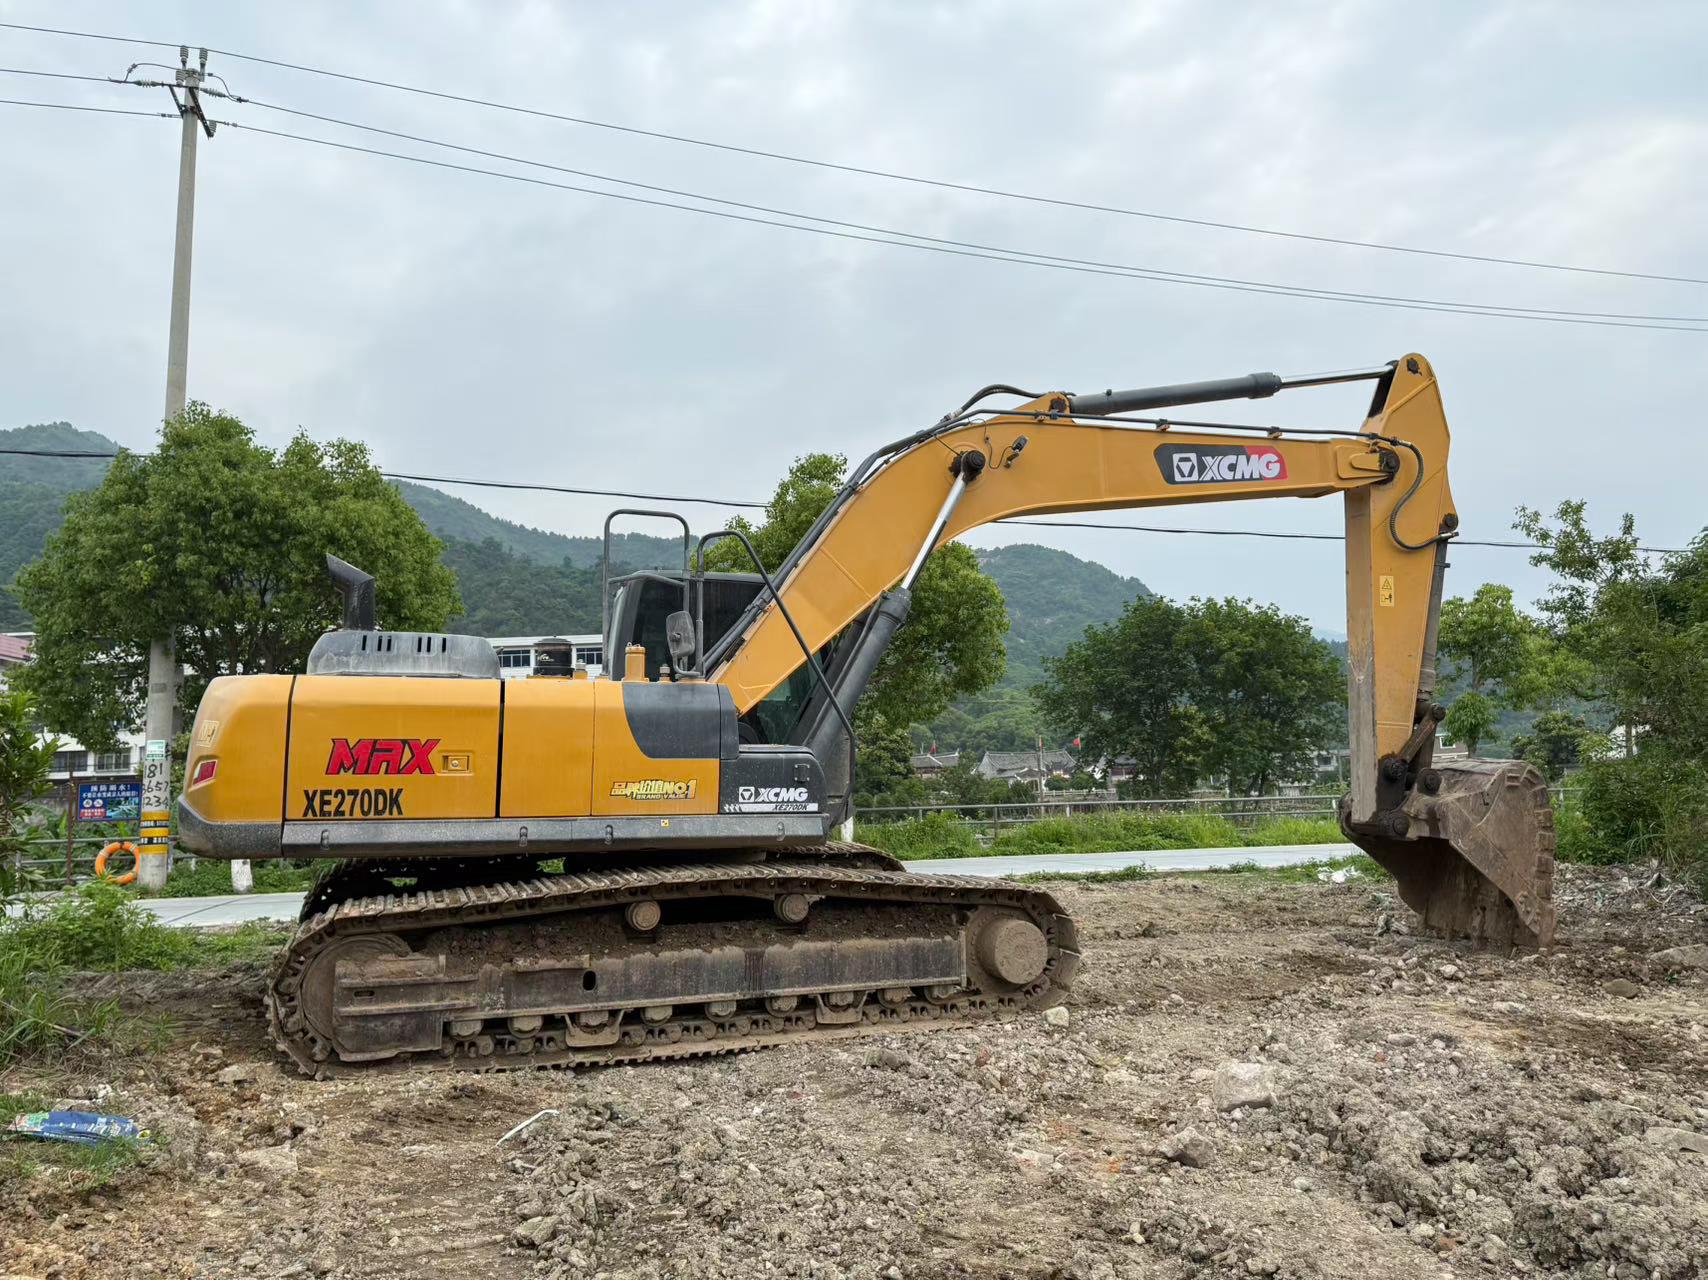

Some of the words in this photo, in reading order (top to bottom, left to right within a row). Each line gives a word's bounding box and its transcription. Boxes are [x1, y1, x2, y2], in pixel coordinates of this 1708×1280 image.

[1199, 453, 1281, 481] XCMG
[325, 739, 441, 775] MAX
[144, 763, 163, 779] 181
[302, 788, 404, 817] XE270DK
[754, 787, 809, 802] XCMG
[772, 803, 809, 811] XE270DK
